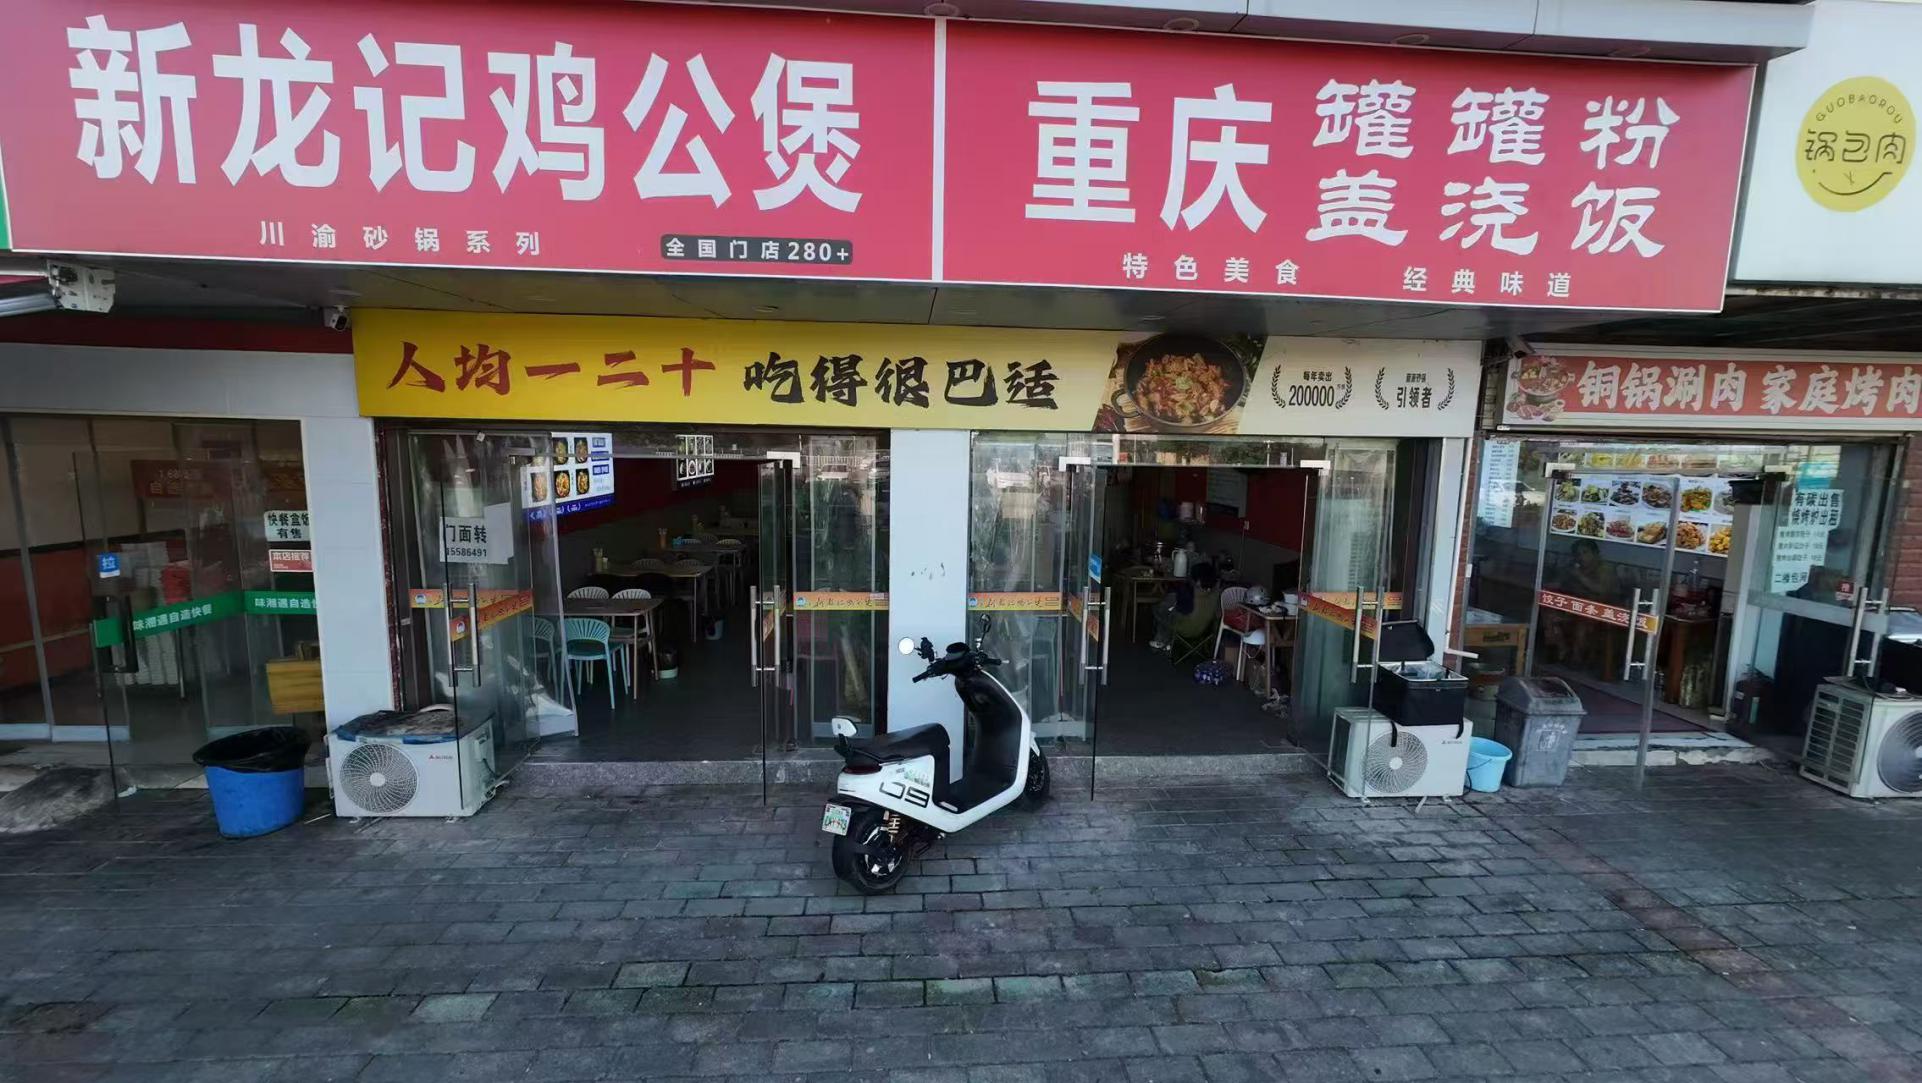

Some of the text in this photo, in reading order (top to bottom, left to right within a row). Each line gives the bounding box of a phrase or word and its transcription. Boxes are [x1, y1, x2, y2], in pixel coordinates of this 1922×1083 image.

[66, 14, 863, 214] 新龙记鸡公煲
[1313, 78, 1680, 171] 罐罐粉
[1815, 94, 1903, 124] GUOBAOROU
[1025, 80, 1273, 234] 重庆
[1804, 128, 1907, 164] 锅包肉
[1305, 168, 1668, 258] 盖浇饭
[259, 220, 541, 256] 川渝砂锅系列
[665, 236, 850, 263] 全国门店280+
[1121, 252, 1571, 298] 特色美食 经典味道
[387, 341, 1062, 411] 人均一二十 吃得很巴适
[1576, 359, 1922, 416] 铜锅涮肉 家庭烤肉
[1288, 384, 1335, 407] 200000
[1396, 386, 1433, 408] 引领者
[276, 528, 302, 539] 有售
[443, 523, 487, 543] 门面转
